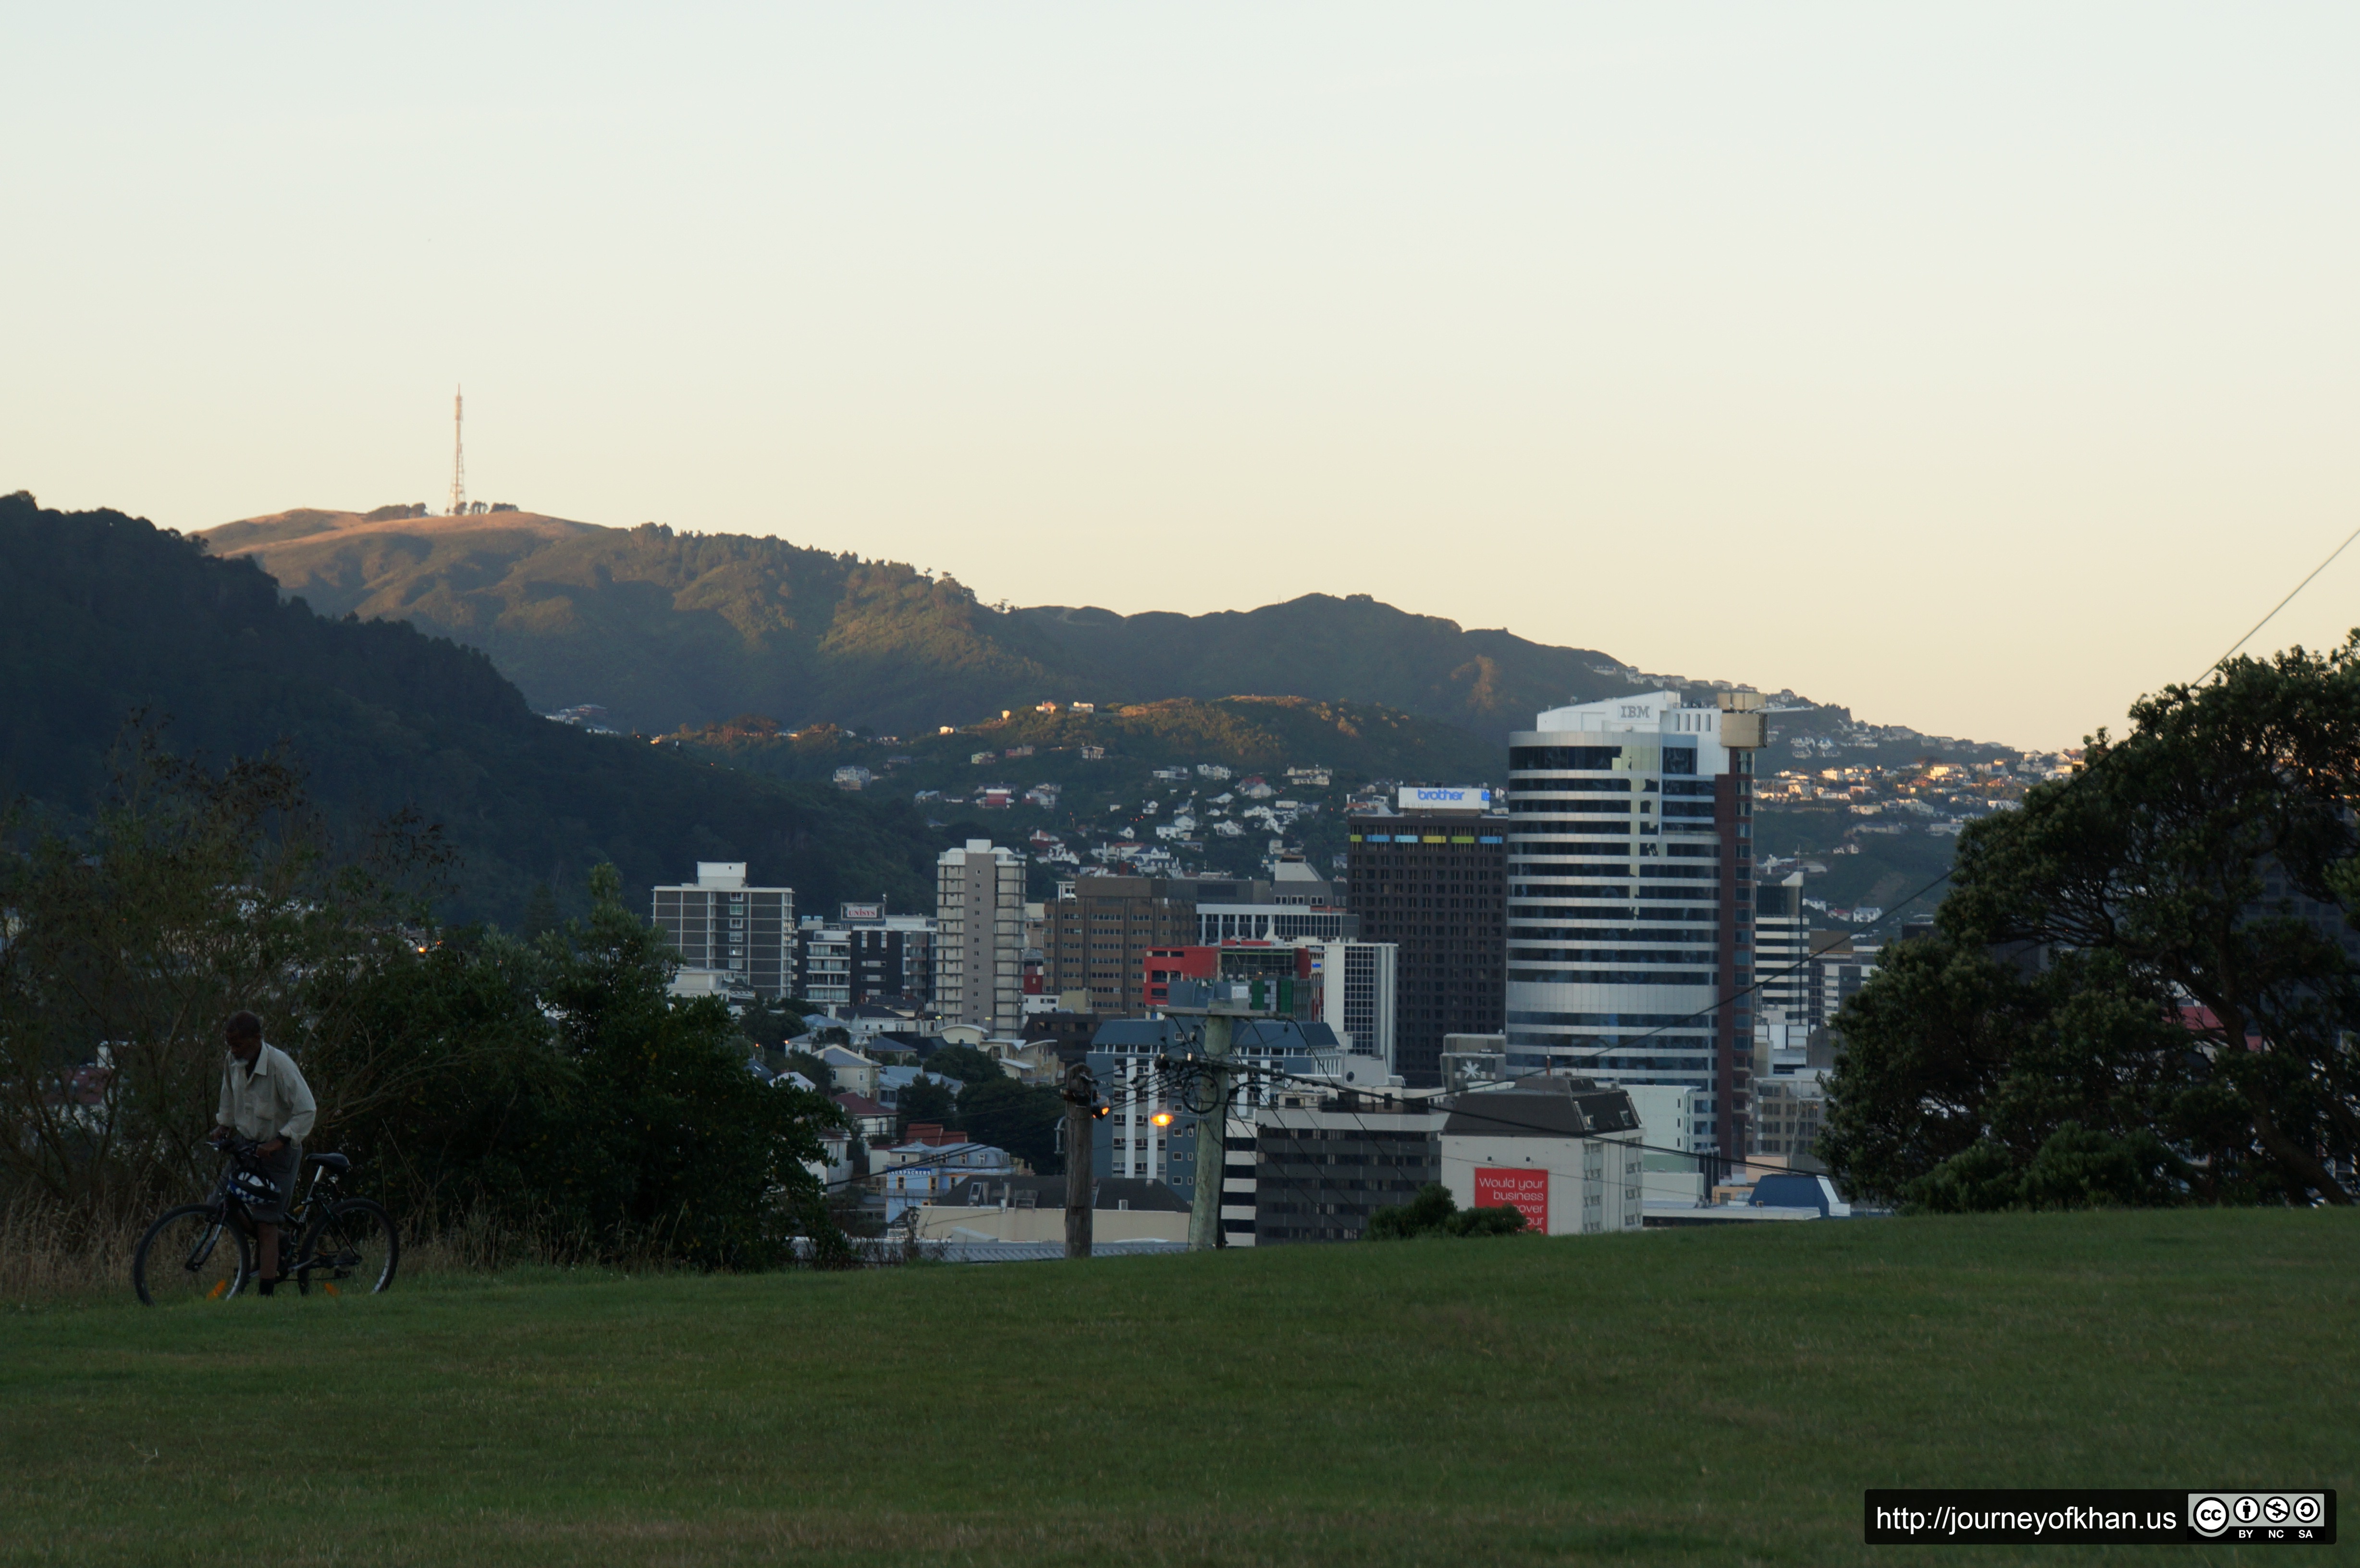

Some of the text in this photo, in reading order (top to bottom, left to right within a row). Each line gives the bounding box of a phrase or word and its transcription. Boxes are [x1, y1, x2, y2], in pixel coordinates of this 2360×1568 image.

[1621, 705, 1650, 718] IBM
[1418, 789, 1464, 800] brother
[848, 907, 876, 916] UNISYS
[1479, 1177, 1544, 1190] Would your
[1493, 1189, 1544, 1201] business
